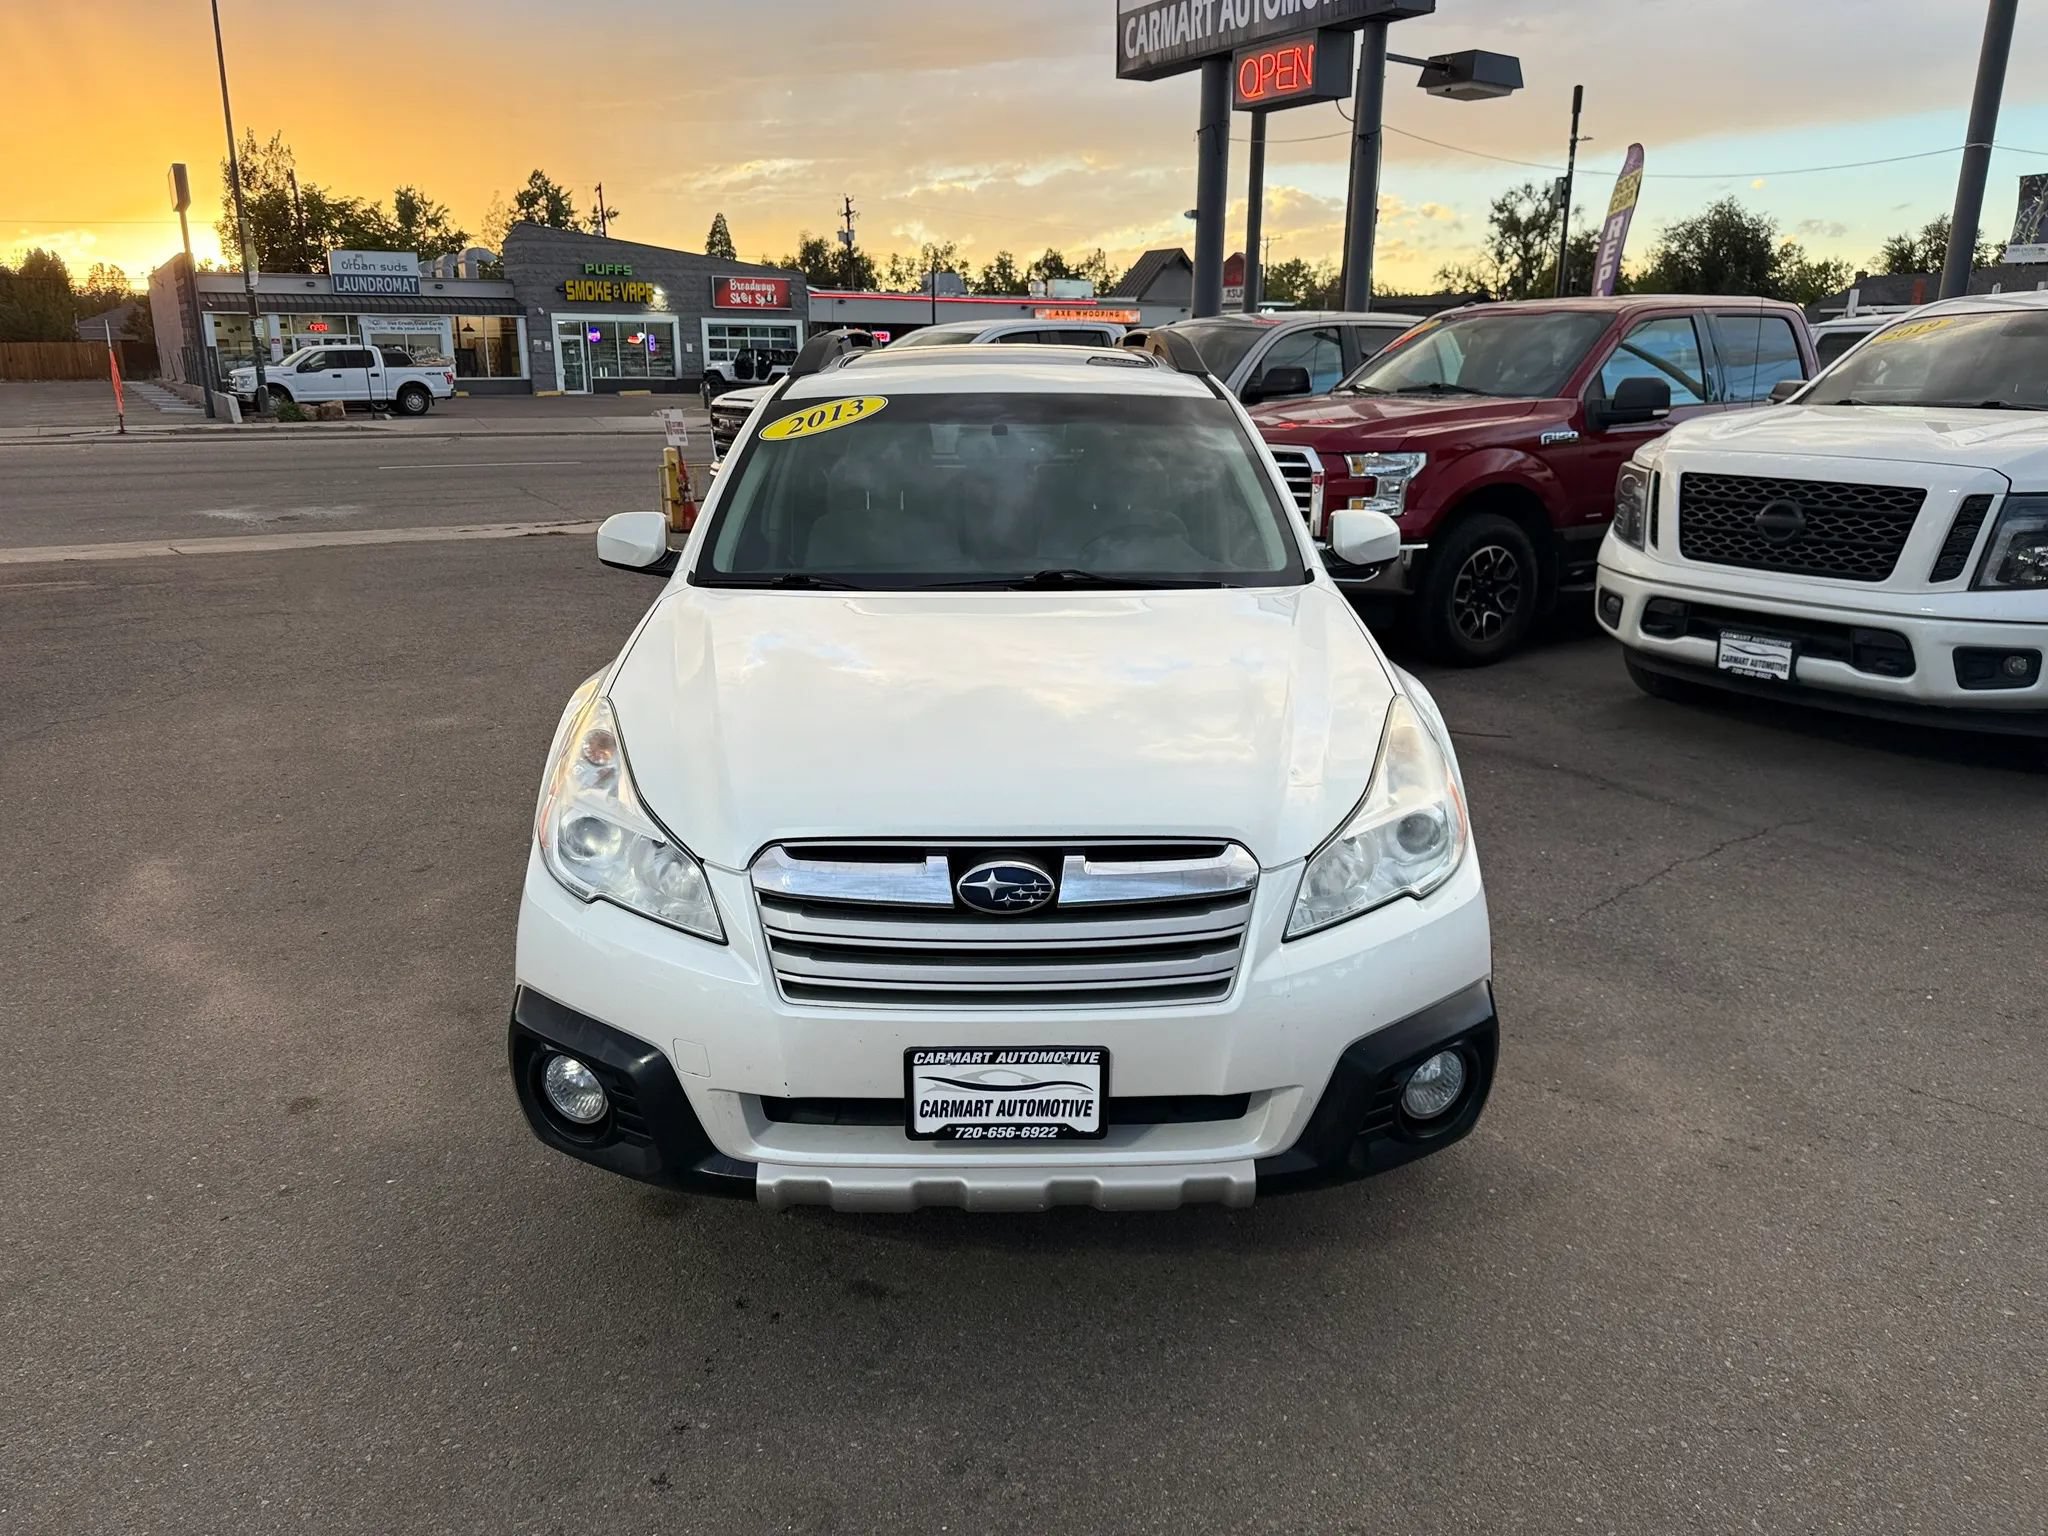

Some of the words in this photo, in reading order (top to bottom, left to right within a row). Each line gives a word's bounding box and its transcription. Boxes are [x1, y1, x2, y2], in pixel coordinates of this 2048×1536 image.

[1125, 0, 1217, 58] CARMART
[1240, 45, 1314, 98] OPEN
[1598, 216, 1624, 296] REP
[380, 262, 408, 272] suds
[584, 263, 633, 276] PUFFS
[335, 276, 417, 293] LAUNDROMAT
[565, 280, 612, 301] SMOKE
[613, 286, 620, 298] &
[620, 282, 654, 303] VAPE
[309, 322, 329, 331] OPEN
[786, 400, 865, 435] 2013
[1721, 654, 1750, 666] CARMART
[1750, 658, 1788, 672] AUTOMOTIVE
[913, 1051, 993, 1065] CARMART
[996, 1051, 1100, 1064] AUTOMOTIVE
[919, 1099, 993, 1118] CARMART
[996, 1098, 1094, 1117] AUTOMOTIVE
[955, 1126, 1058, 1139] 720-656-6922
